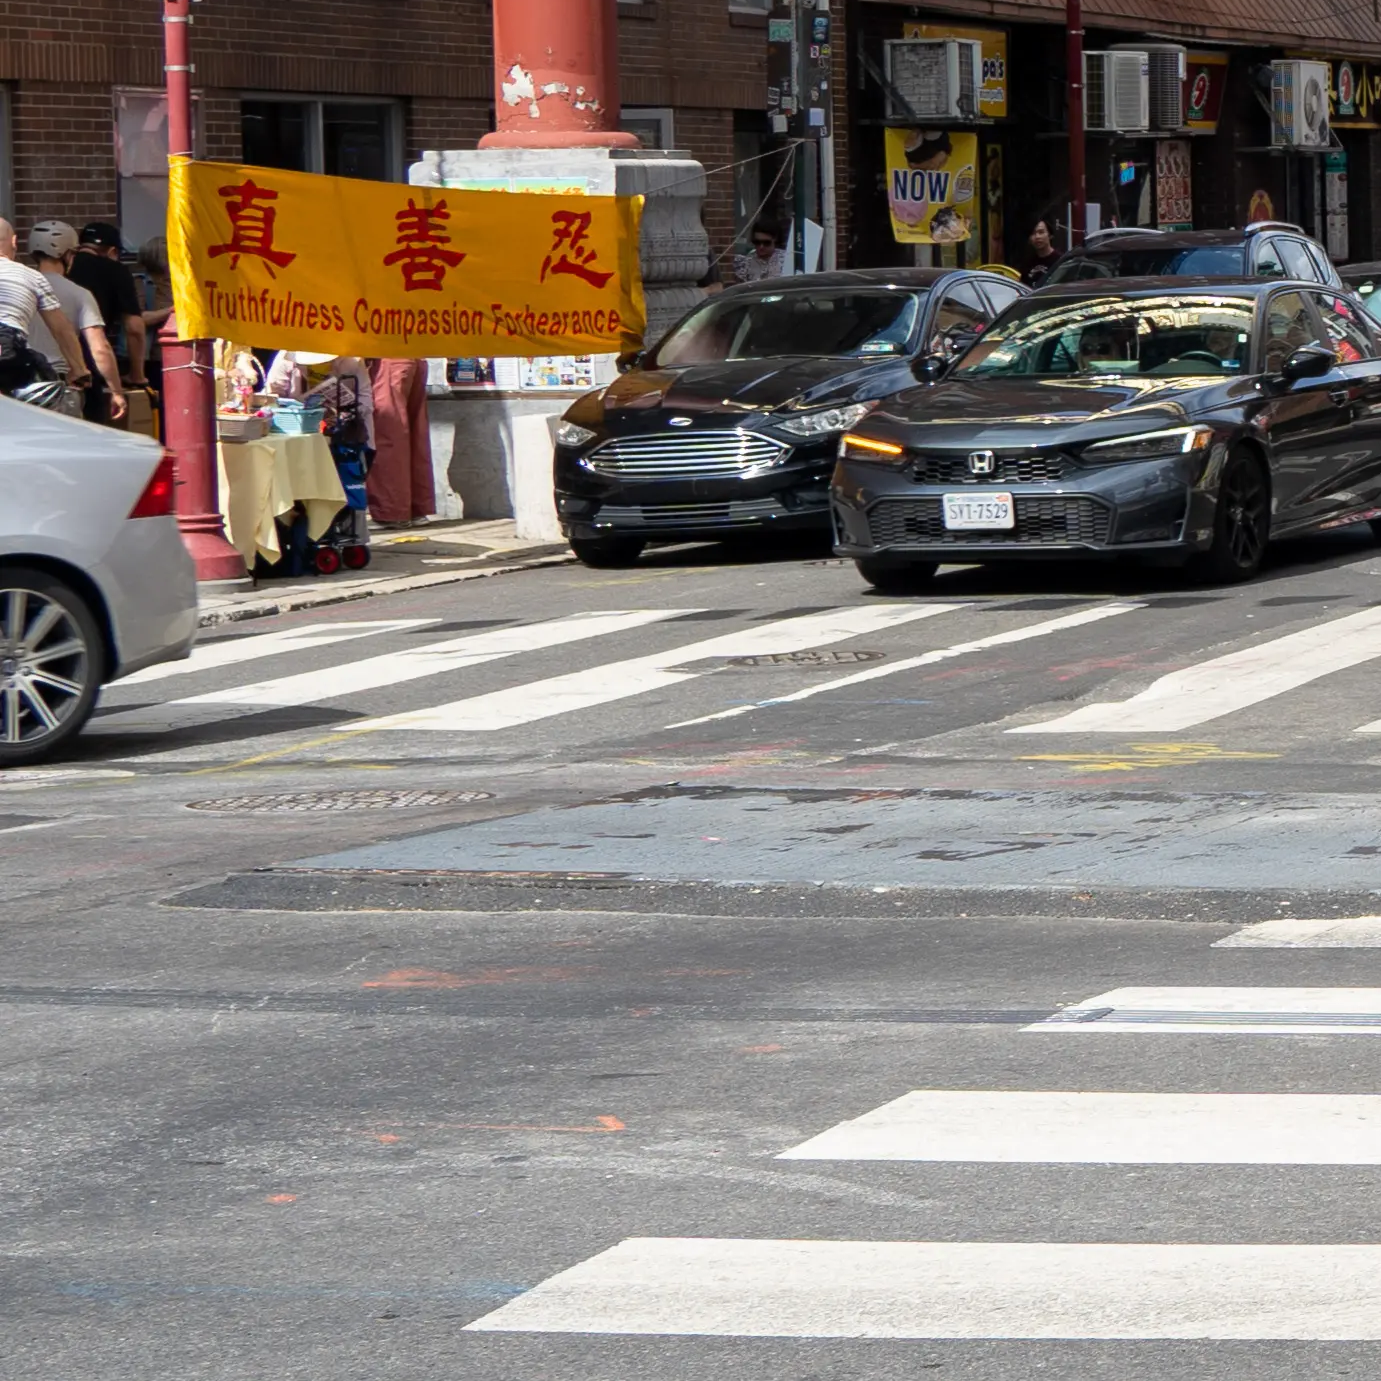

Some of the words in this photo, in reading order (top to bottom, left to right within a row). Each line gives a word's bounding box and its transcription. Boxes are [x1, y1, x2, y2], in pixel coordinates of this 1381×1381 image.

[893, 169, 951, 203] NOW
[205, 281, 346, 333] Truthfulness
[353, 297, 483, 344] Compassion
